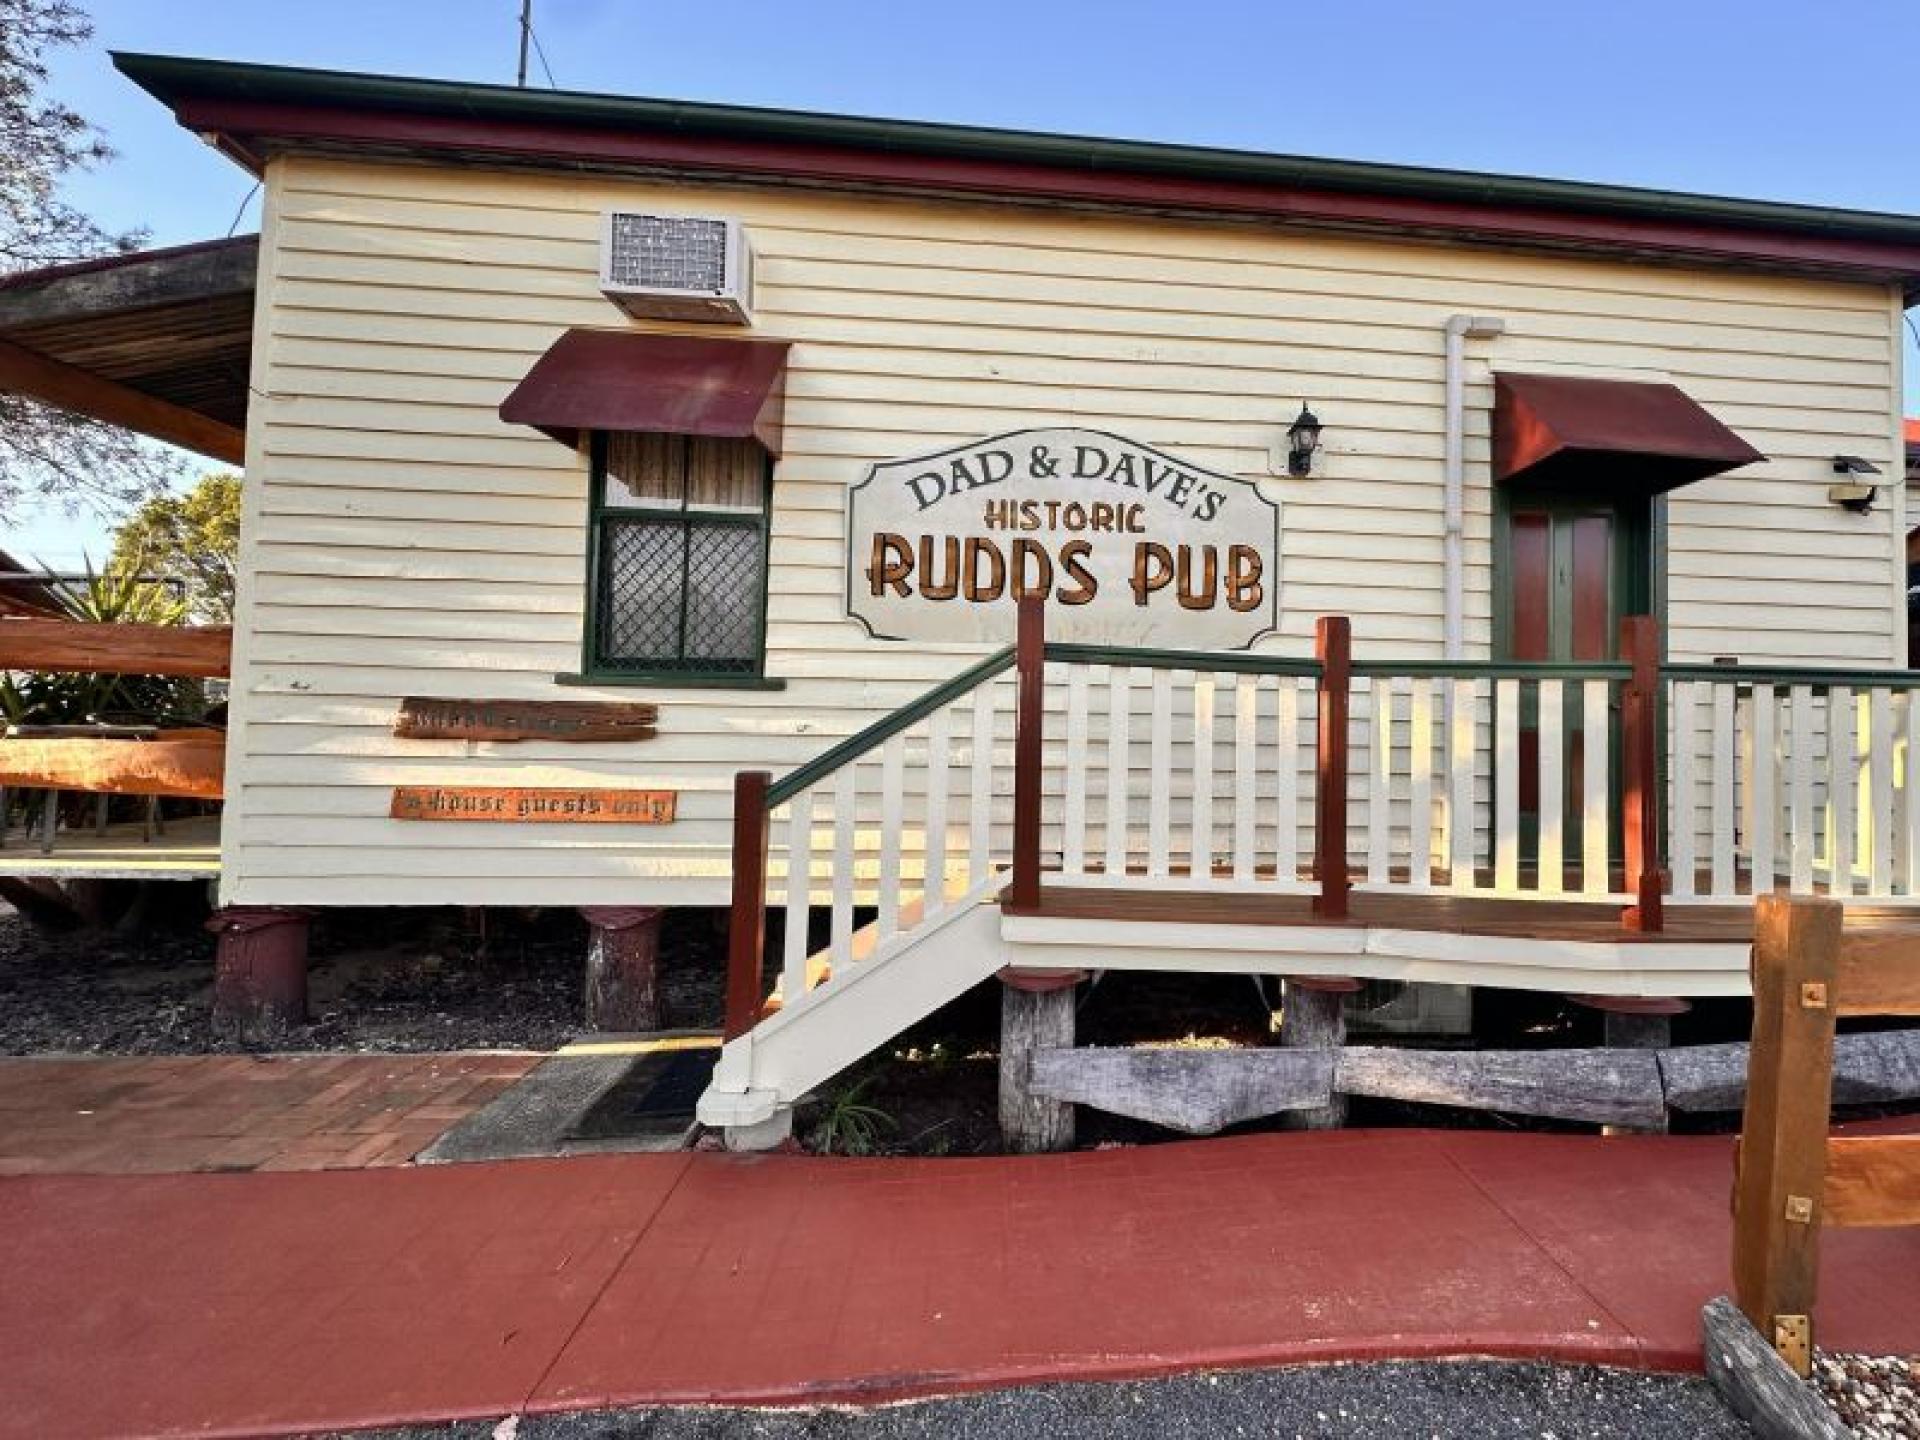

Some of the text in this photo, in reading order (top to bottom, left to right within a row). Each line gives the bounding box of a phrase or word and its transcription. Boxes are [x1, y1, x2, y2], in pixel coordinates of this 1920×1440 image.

[905, 445, 1227, 521] DAD & DAVE'S
[983, 499, 1146, 534] HISTORIC
[866, 532, 1264, 613] RUDDS PUB
[518, 792, 601, 817] guests
